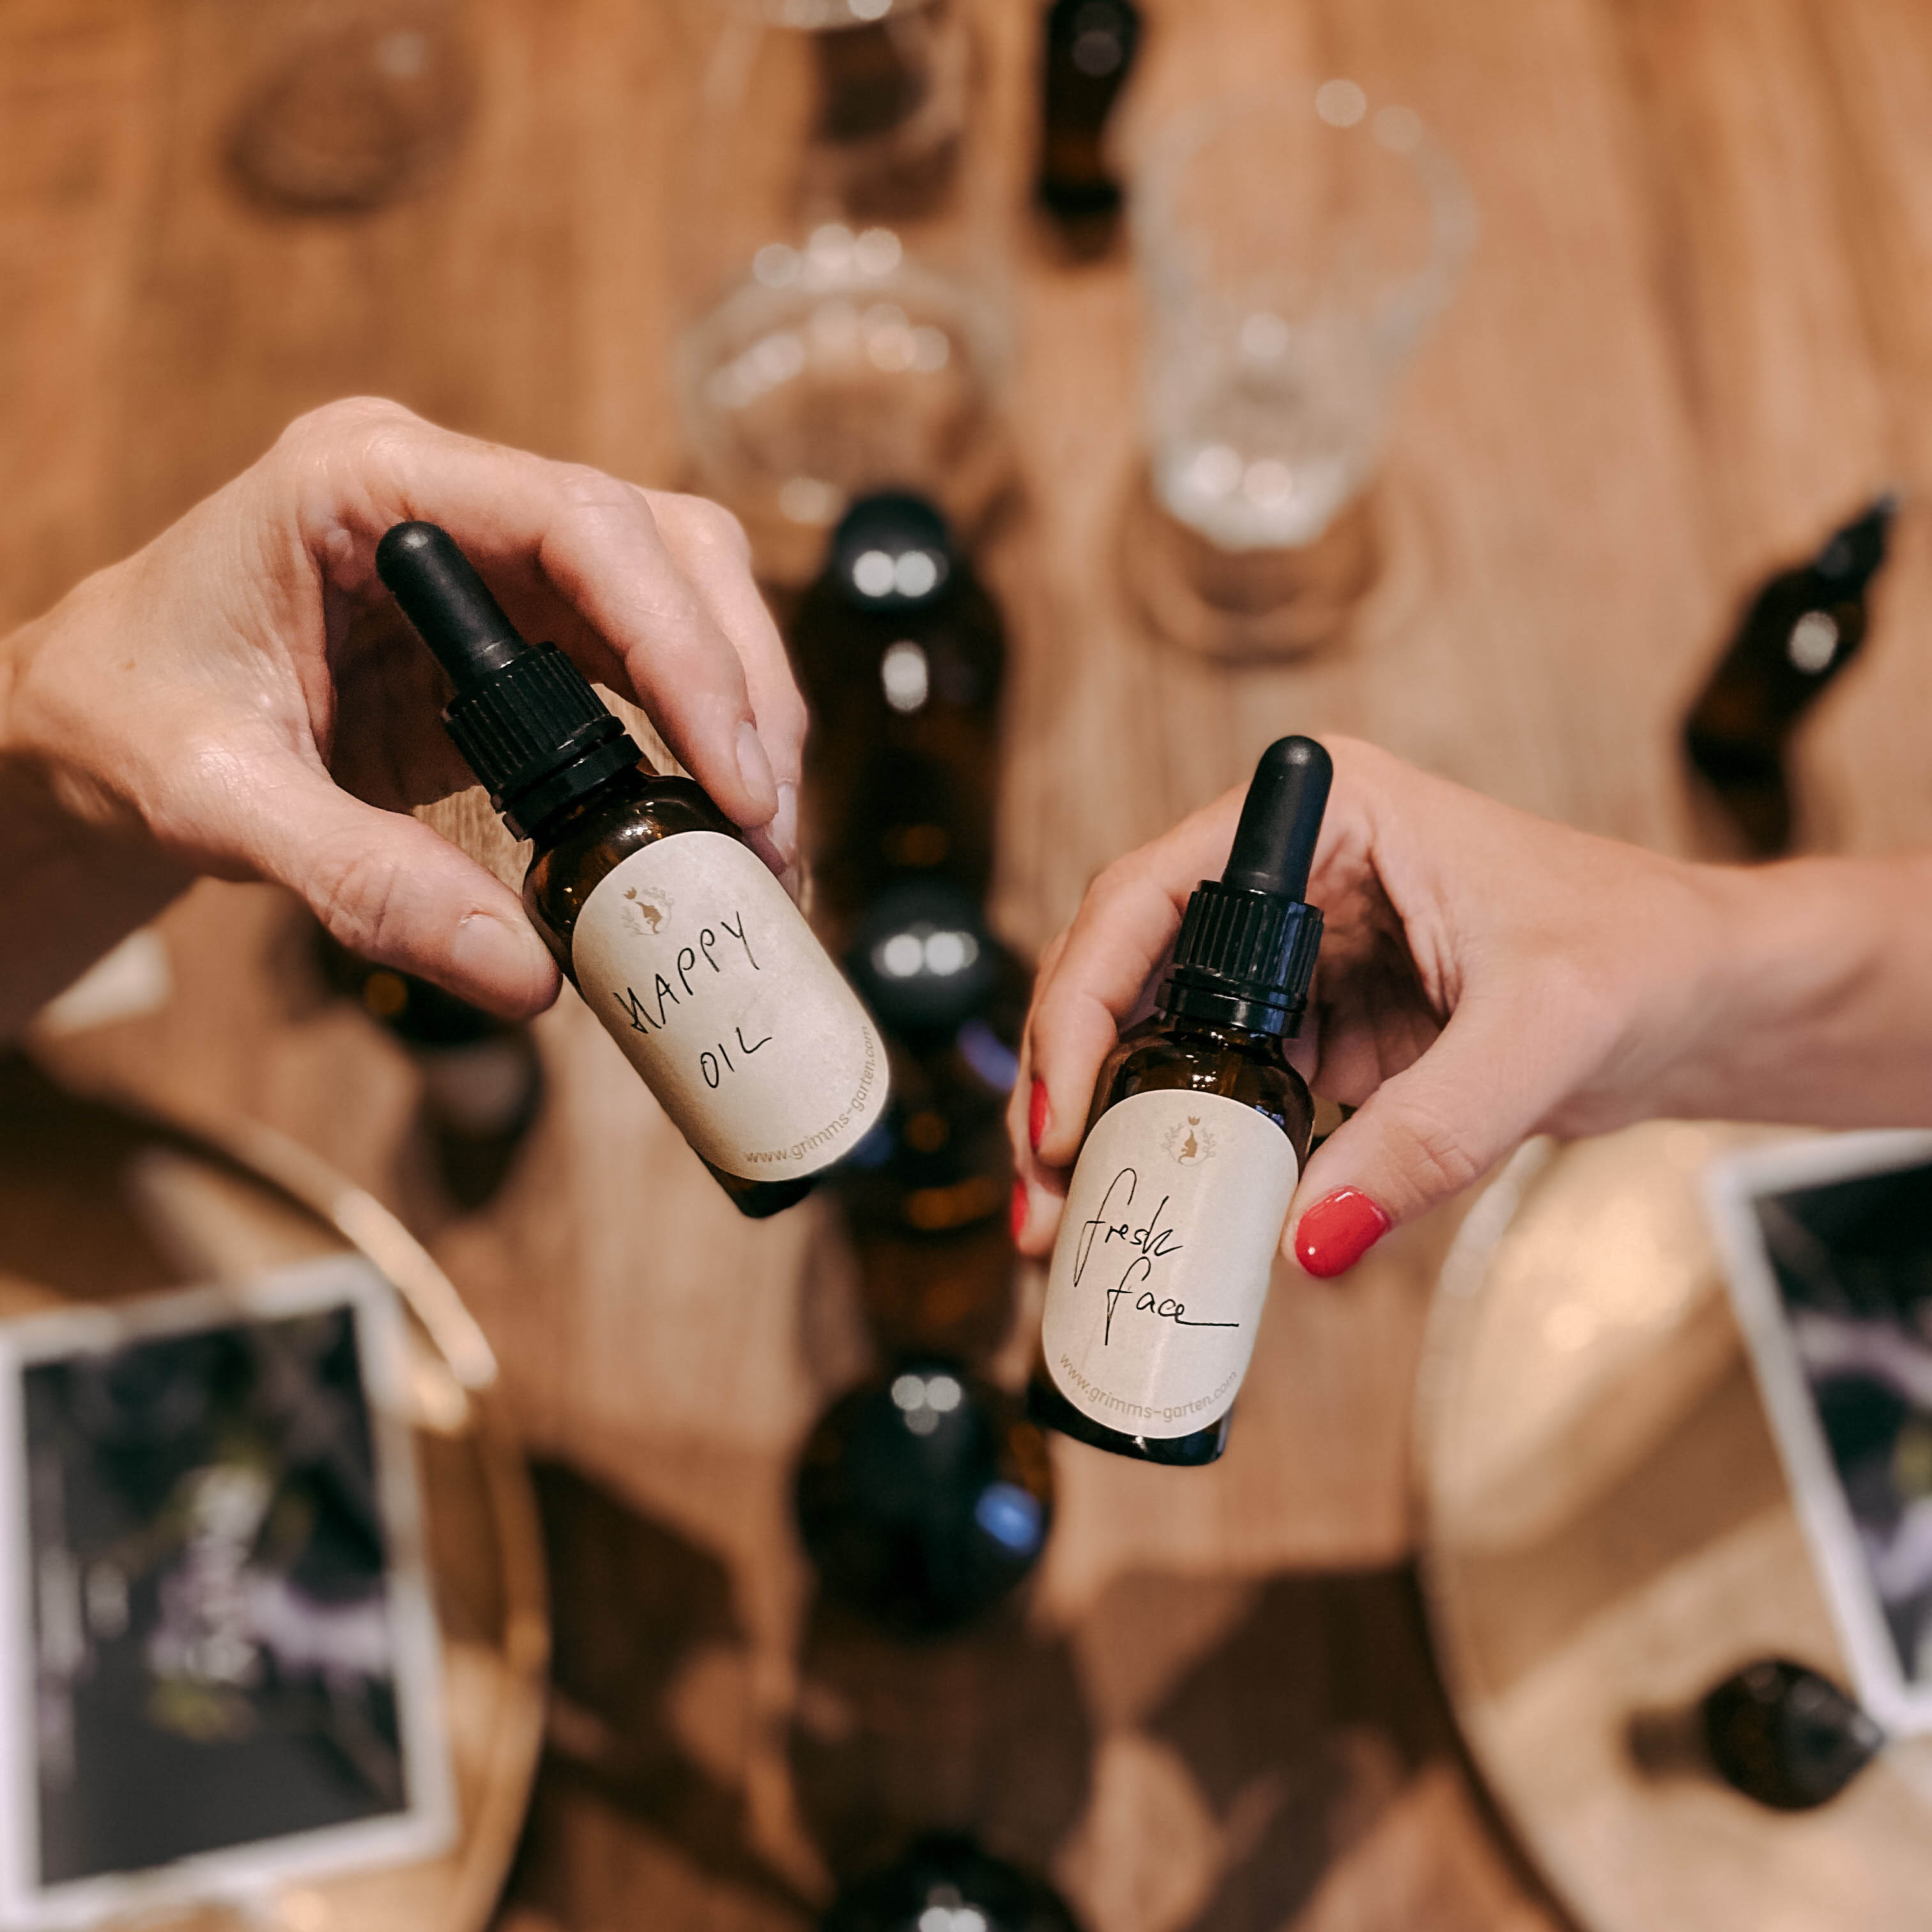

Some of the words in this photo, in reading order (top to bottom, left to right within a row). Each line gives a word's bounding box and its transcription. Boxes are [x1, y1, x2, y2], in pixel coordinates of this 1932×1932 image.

[613, 910, 760, 1034] HAPPY
[700, 1027, 772, 1089] OIL
[746, 1025, 875, 1163] www.grimms-garten.com
[1073, 1167, 1183, 1288] fresh
[1105, 1256, 1239, 1346] face
[1060, 1353, 1238, 1422] www.grimms-garten.com
